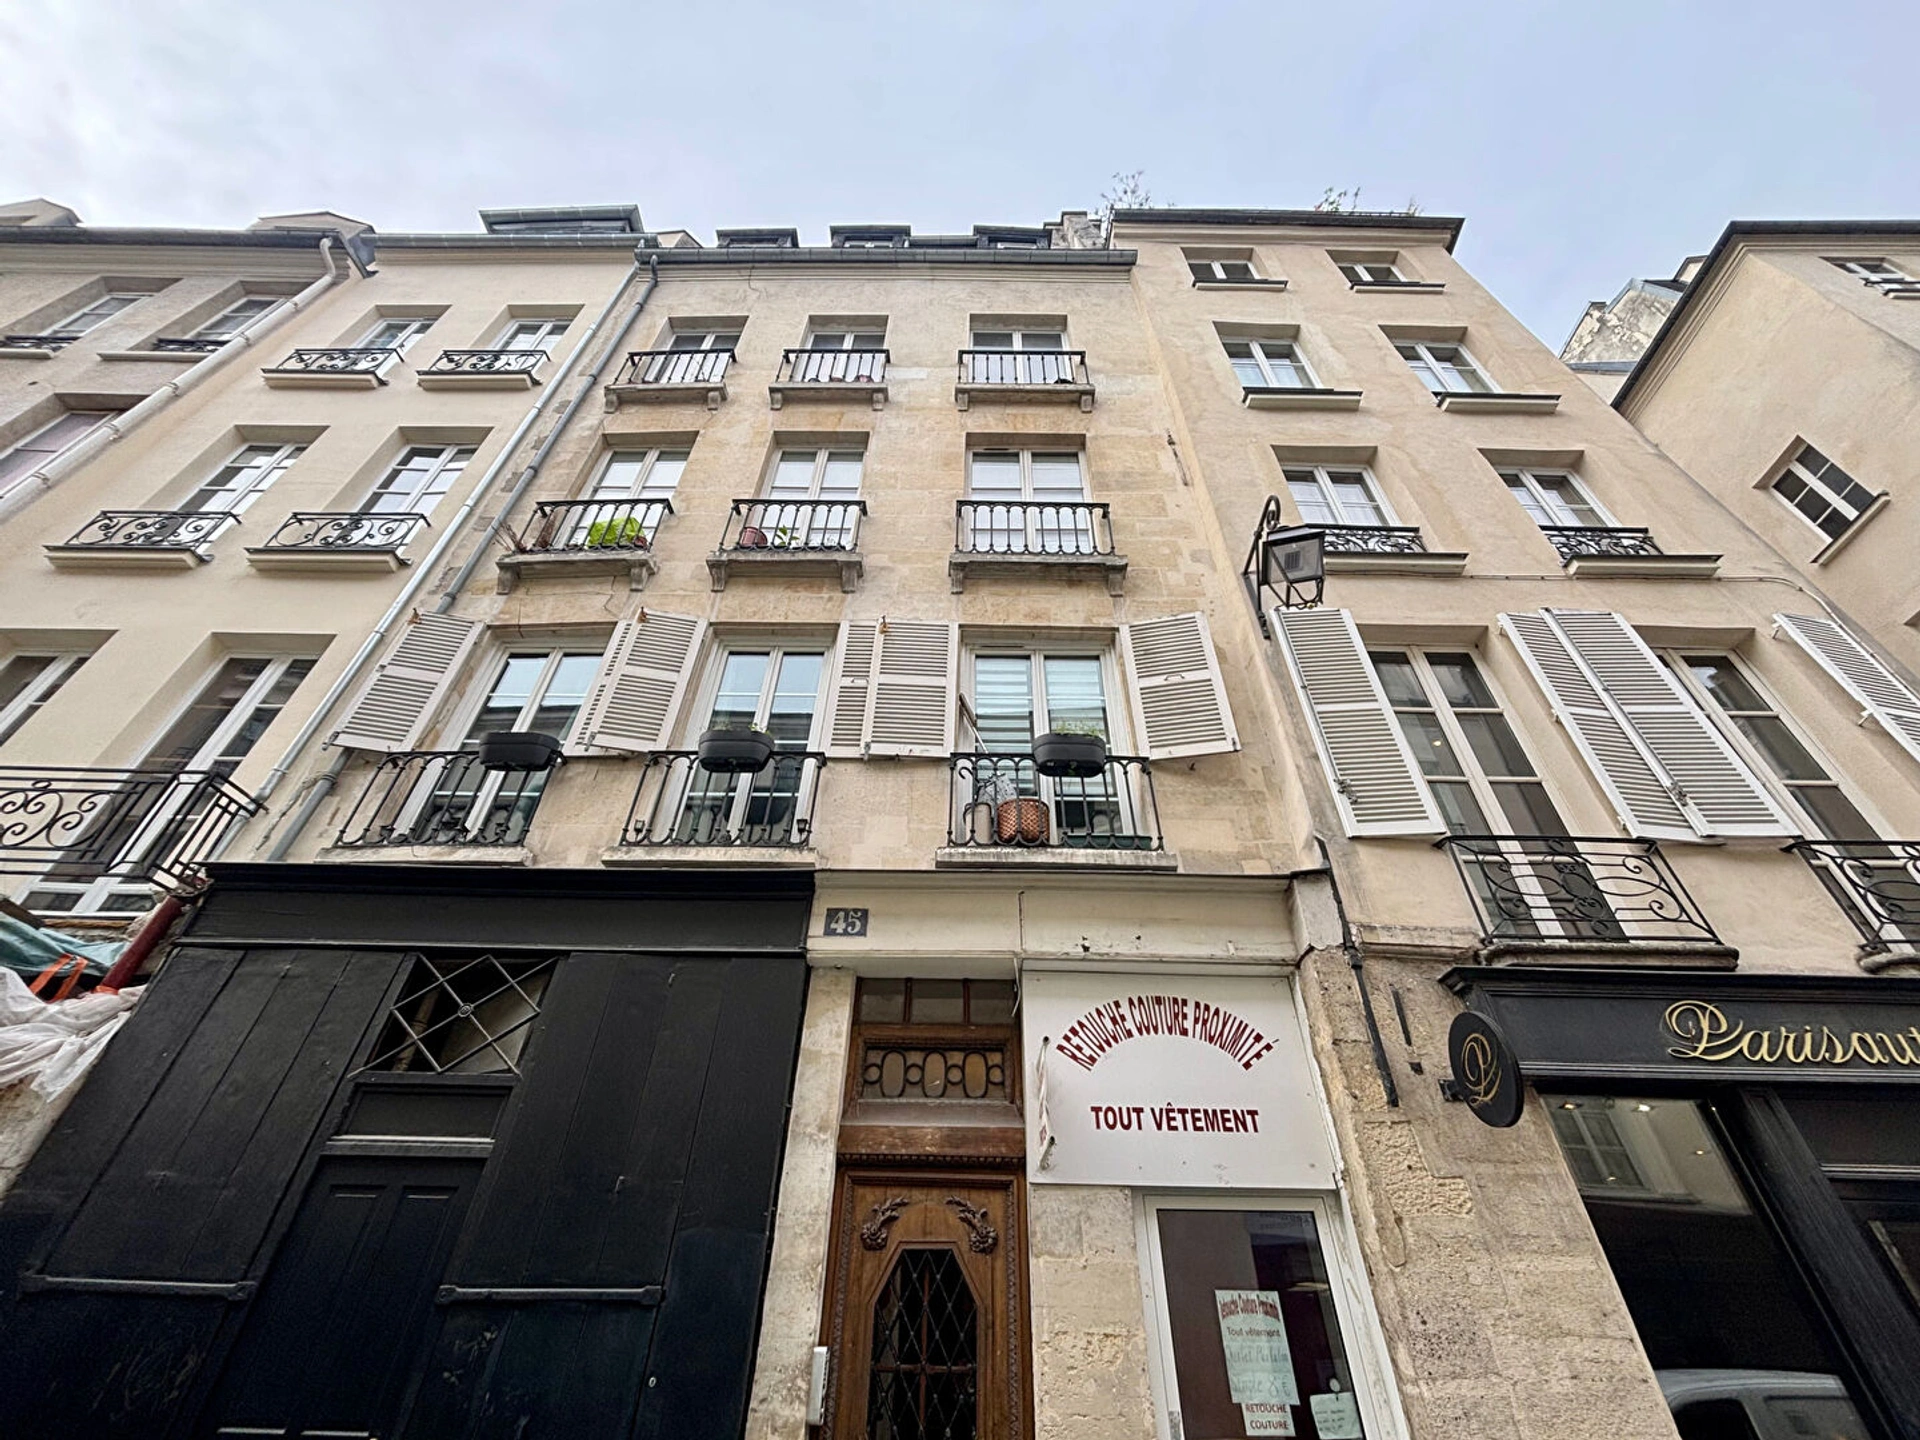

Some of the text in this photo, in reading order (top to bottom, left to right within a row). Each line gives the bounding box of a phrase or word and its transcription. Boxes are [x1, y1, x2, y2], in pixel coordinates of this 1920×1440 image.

[830, 910, 862, 934] 45
[1056, 995, 1280, 1071] RETOUCHE COUTURE PROXIMITÉ
[1090, 1102, 1260, 1133] TOUT VÊTEMENT
[1245, 1404, 1288, 1414] RETOUCHE
[1250, 1420, 1289, 1431] COUTURE
